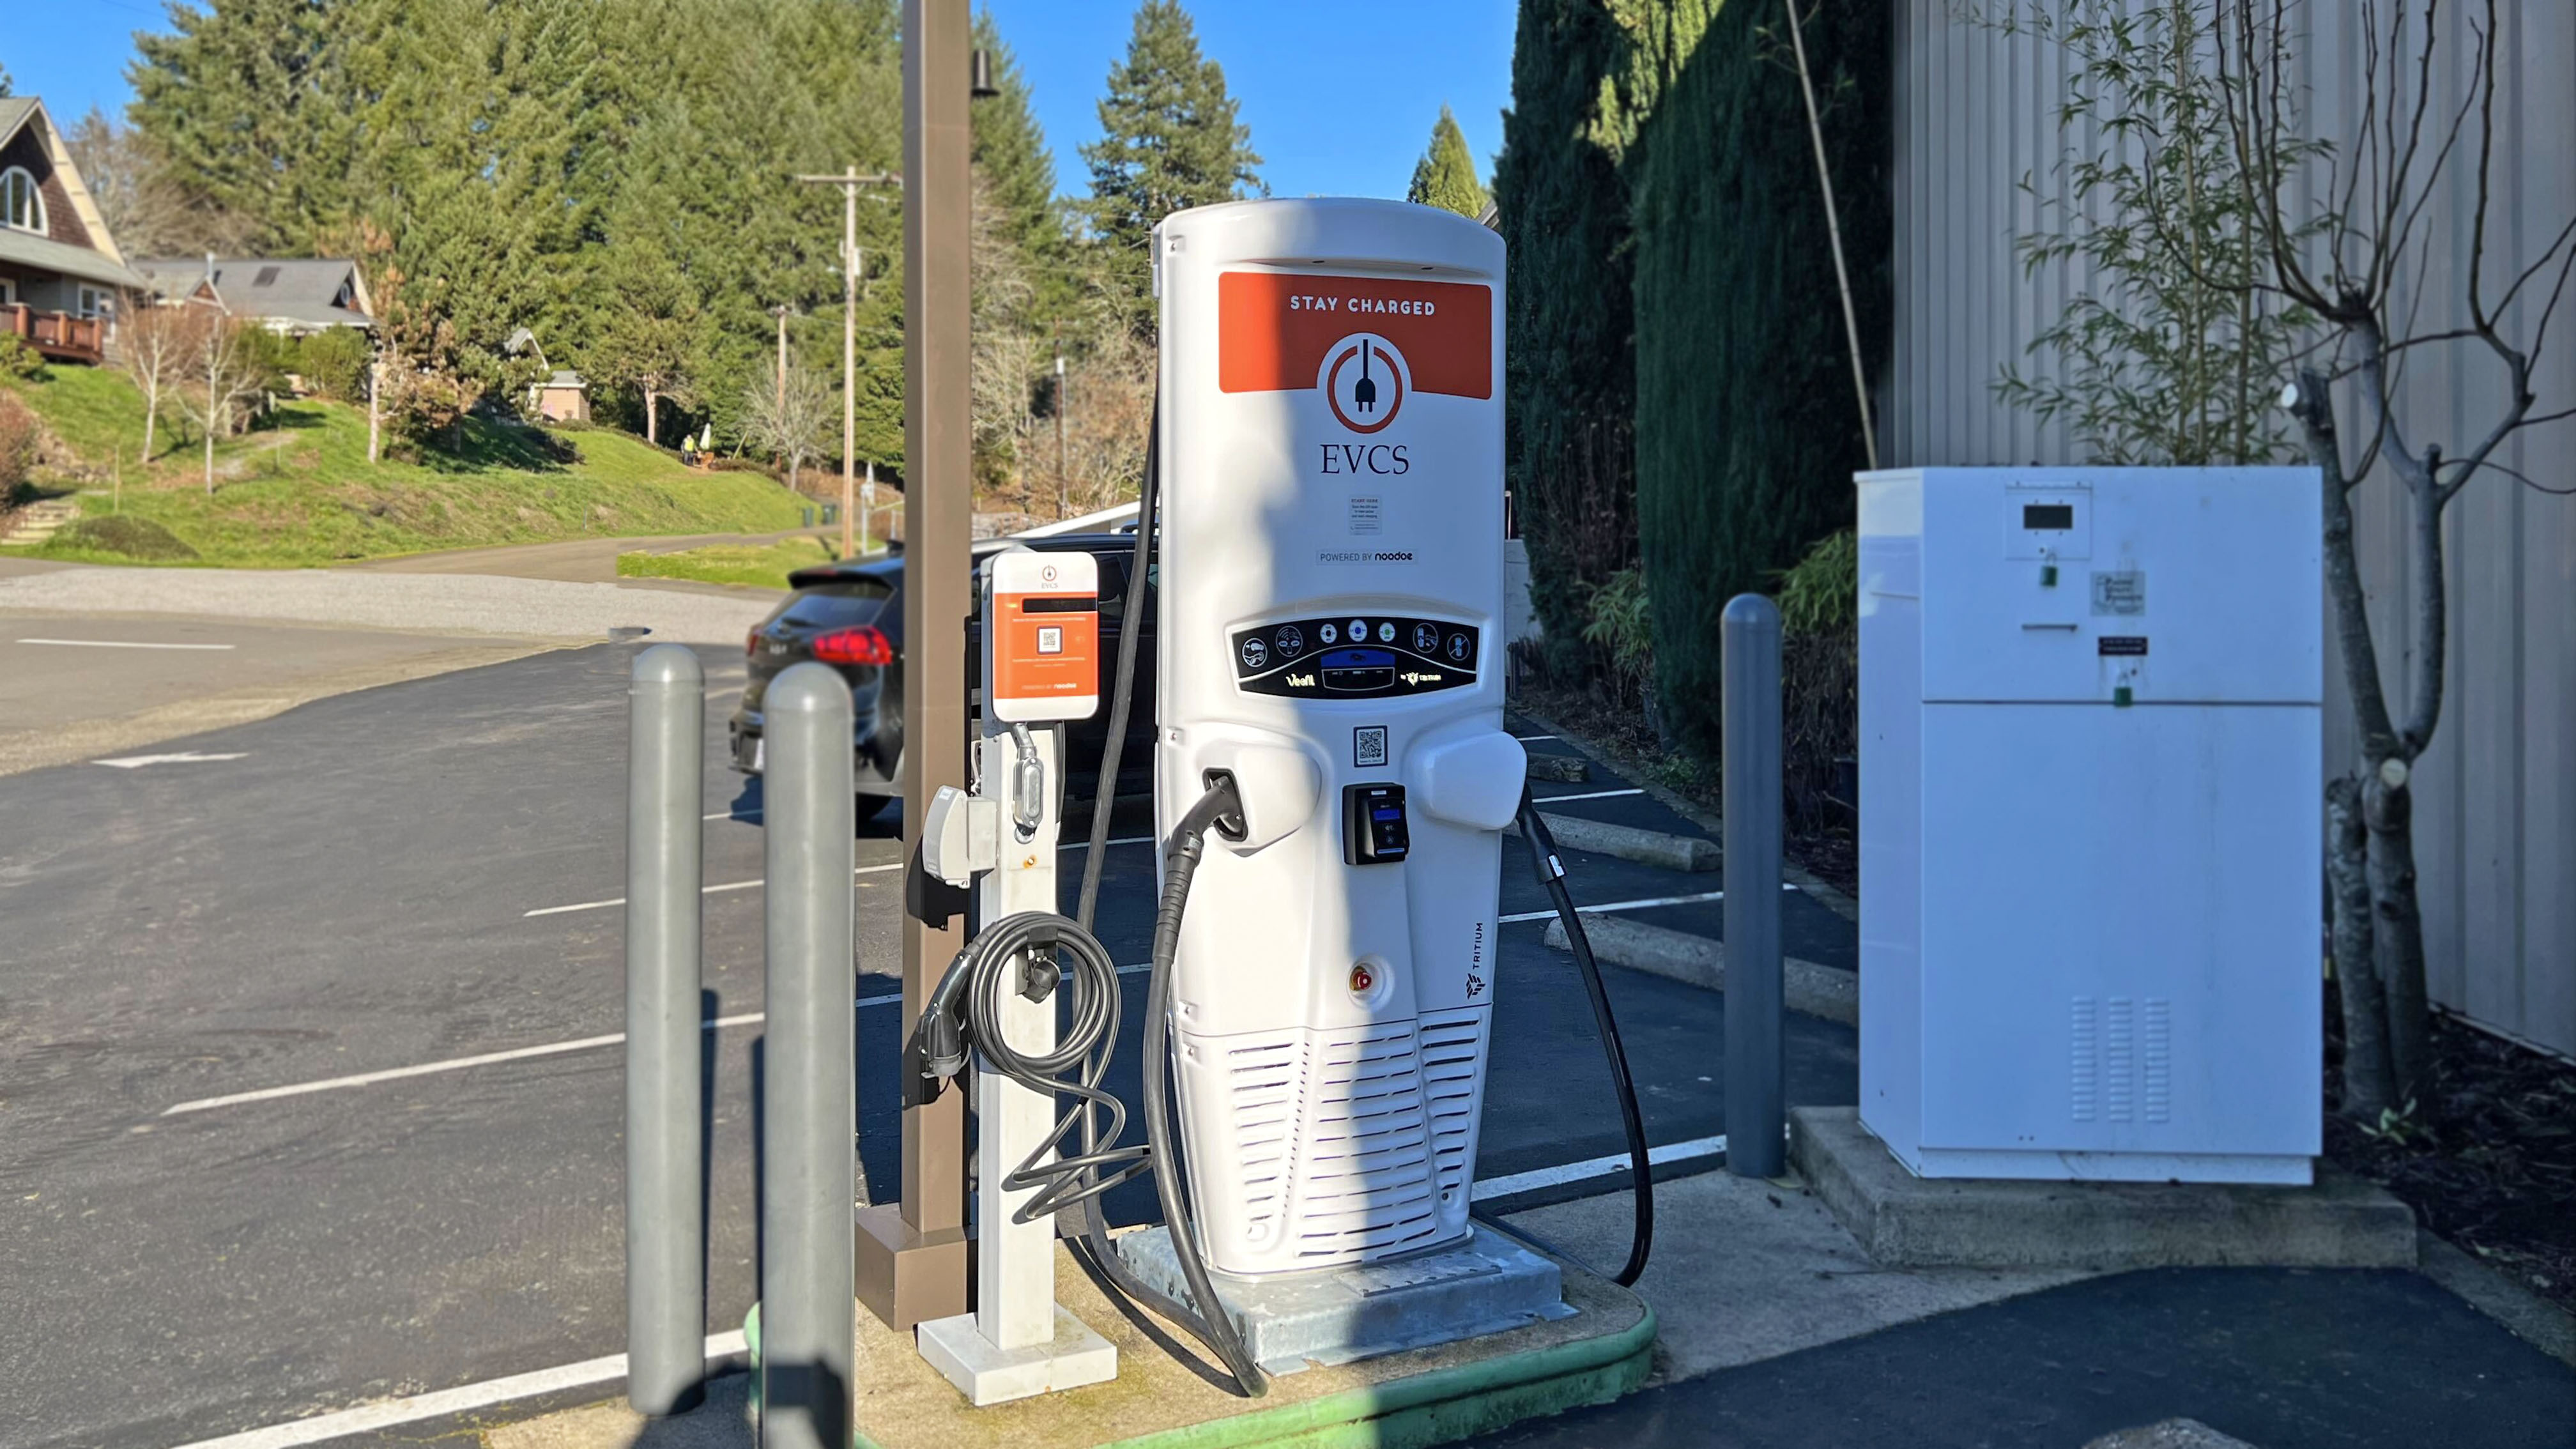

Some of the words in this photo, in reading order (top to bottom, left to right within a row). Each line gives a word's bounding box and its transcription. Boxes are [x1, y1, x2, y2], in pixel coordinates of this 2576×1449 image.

[1291, 295, 1338, 311] STAY
[1347, 297, 1435, 316] CHARGED
[1320, 444, 1409, 474] EVCS
[1320, 553, 1360, 561] POWERED
[1362, 553, 1372, 561] BY
[1374, 551, 1413, 561] noodoe
[1472, 923, 1483, 970] TRITIUM
